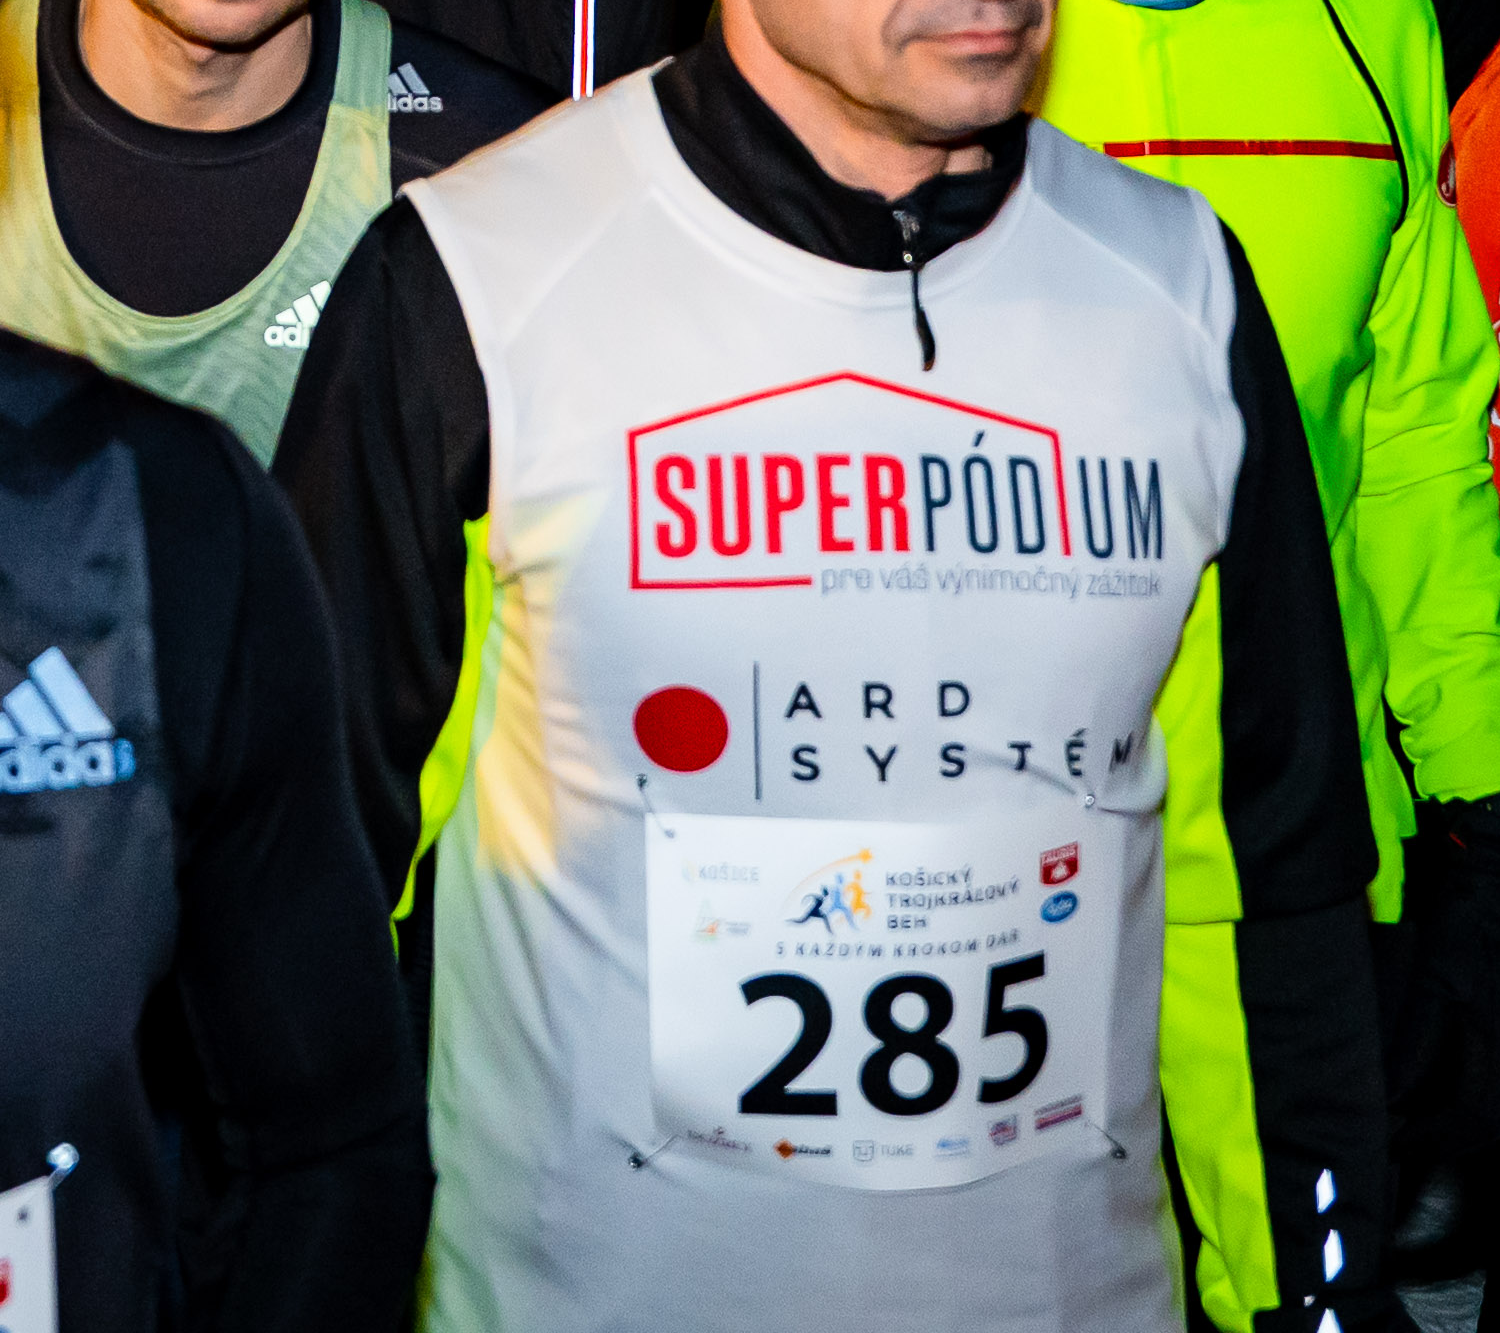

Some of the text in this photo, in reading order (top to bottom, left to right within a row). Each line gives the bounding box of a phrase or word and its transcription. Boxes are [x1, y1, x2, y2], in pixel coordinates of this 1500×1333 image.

[388, 92, 444, 113] idas
[653, 429, 1166, 561] SUPERPÓDIUM
[821, 565, 871, 596] pre
[879, 561, 930, 591] váš
[934, 561, 1080, 598] výnimočný
[887, 913, 929, 931] BEH
[738, 949, 1050, 1117] 285
